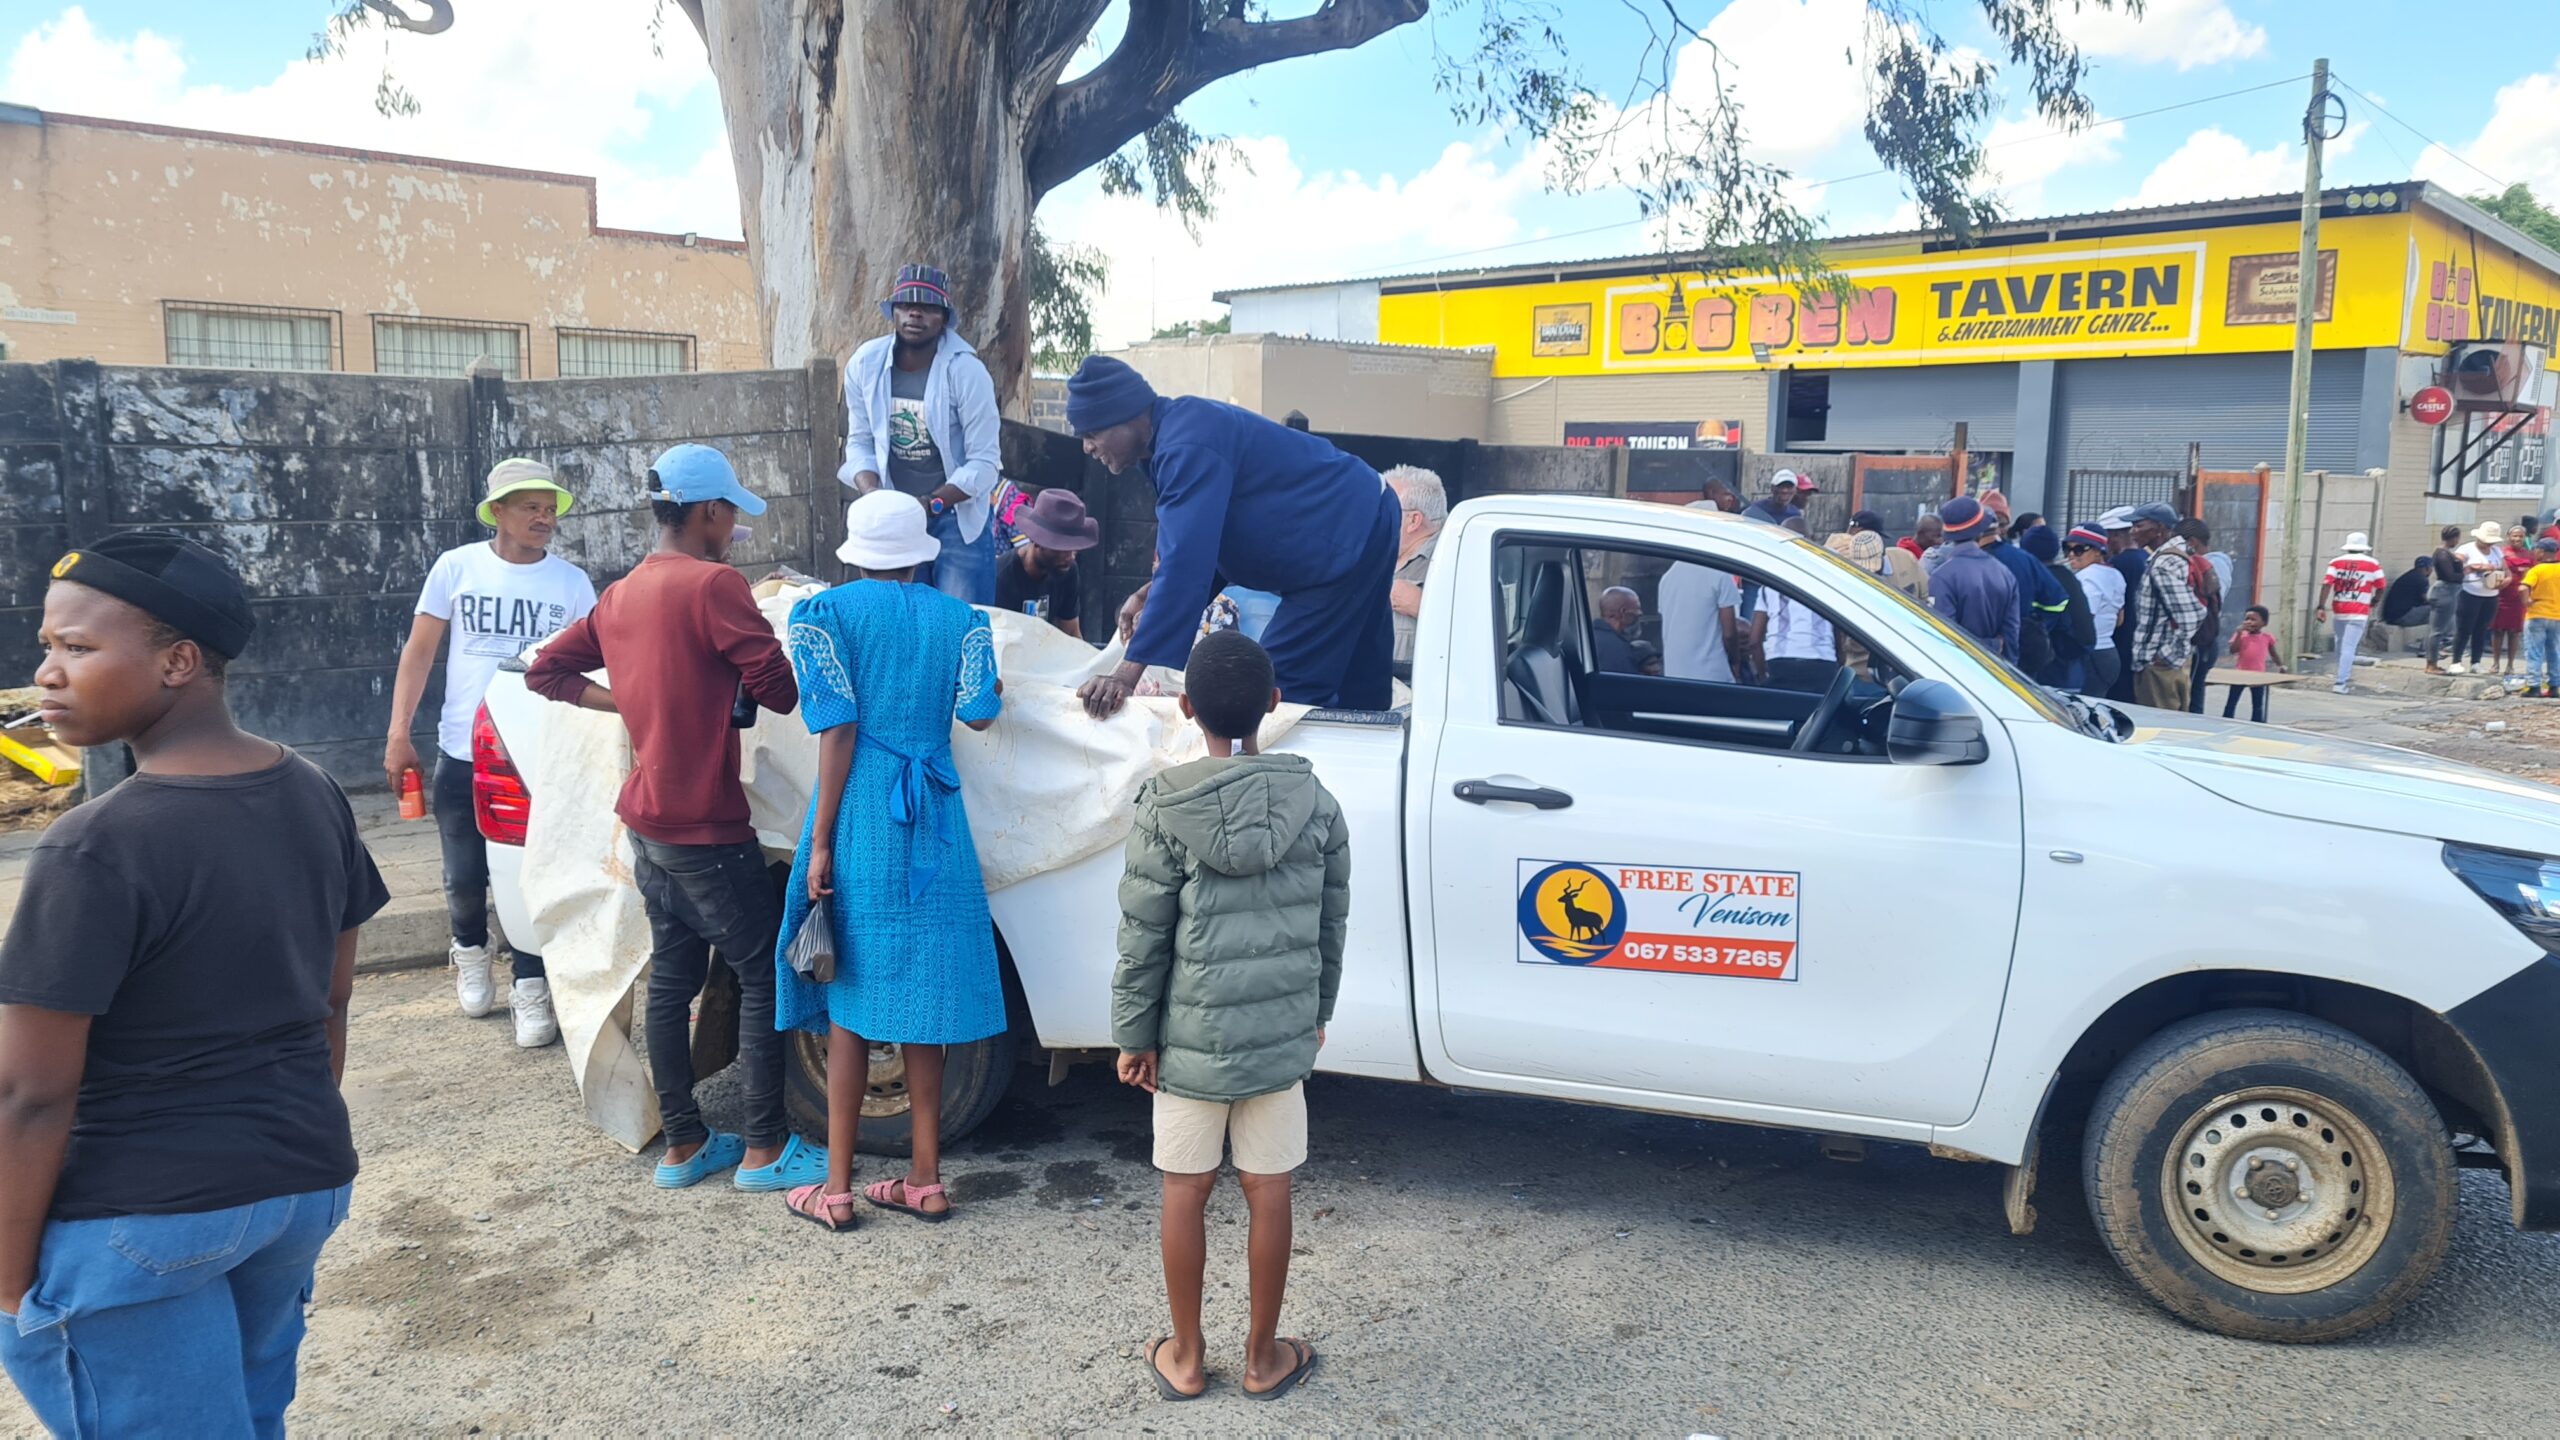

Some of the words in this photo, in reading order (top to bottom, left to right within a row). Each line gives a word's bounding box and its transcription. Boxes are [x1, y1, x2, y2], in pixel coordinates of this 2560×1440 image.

[1931, 264, 2180, 319] TAVERN
[1749, 286, 1898, 349] BEN
[1951, 315, 2085, 342] ENTERTAINMENT
[2088, 311, 2171, 335] CENTRE...
[2425, 302, 2470, 341] BEN
[2480, 295, 2560, 359] TAVERN
[2417, 402, 2447, 410] CASTLE
[1618, 868, 1695, 893] FREE
[1702, 873, 1795, 897] STATE
[1678, 892, 1793, 928] Venison
[1623, 941, 1668, 960] 067
[1672, 945, 1718, 964] 533
[1723, 947, 1784, 968] 7265
